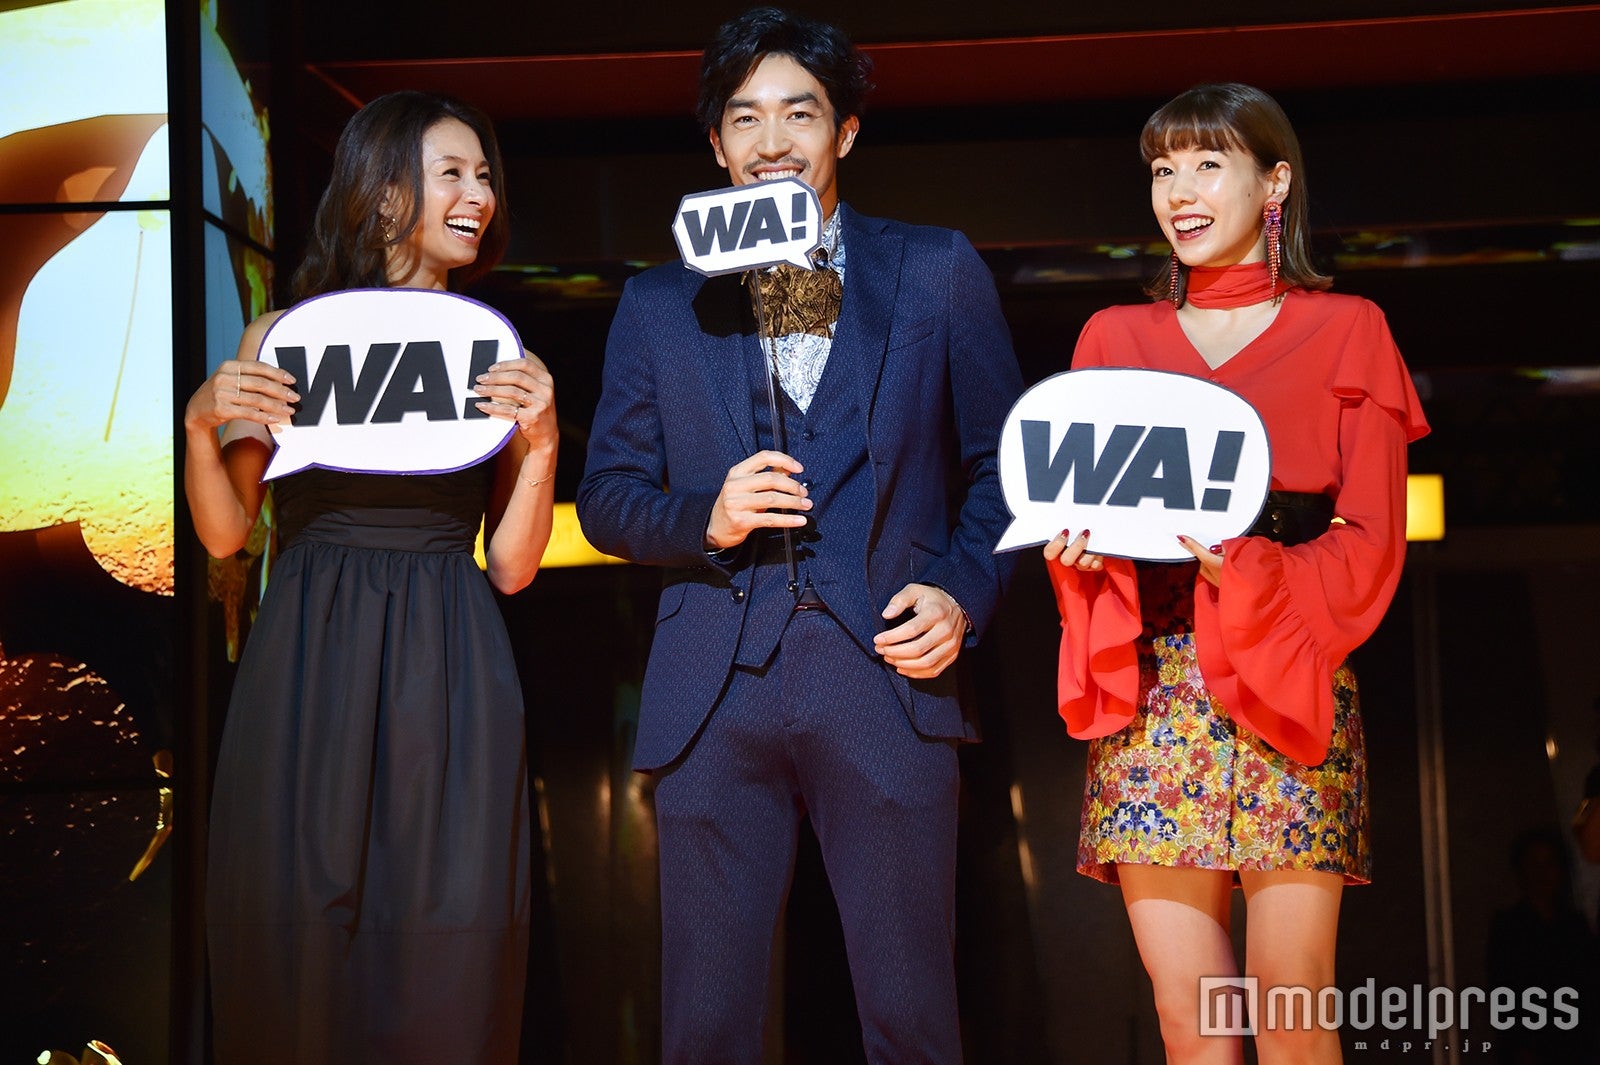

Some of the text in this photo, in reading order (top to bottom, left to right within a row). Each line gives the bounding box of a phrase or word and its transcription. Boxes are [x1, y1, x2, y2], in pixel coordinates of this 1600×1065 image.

[681, 191, 807, 257] WA!
[274, 339, 499, 427] WA!
[1020, 419, 1245, 512] WA!
